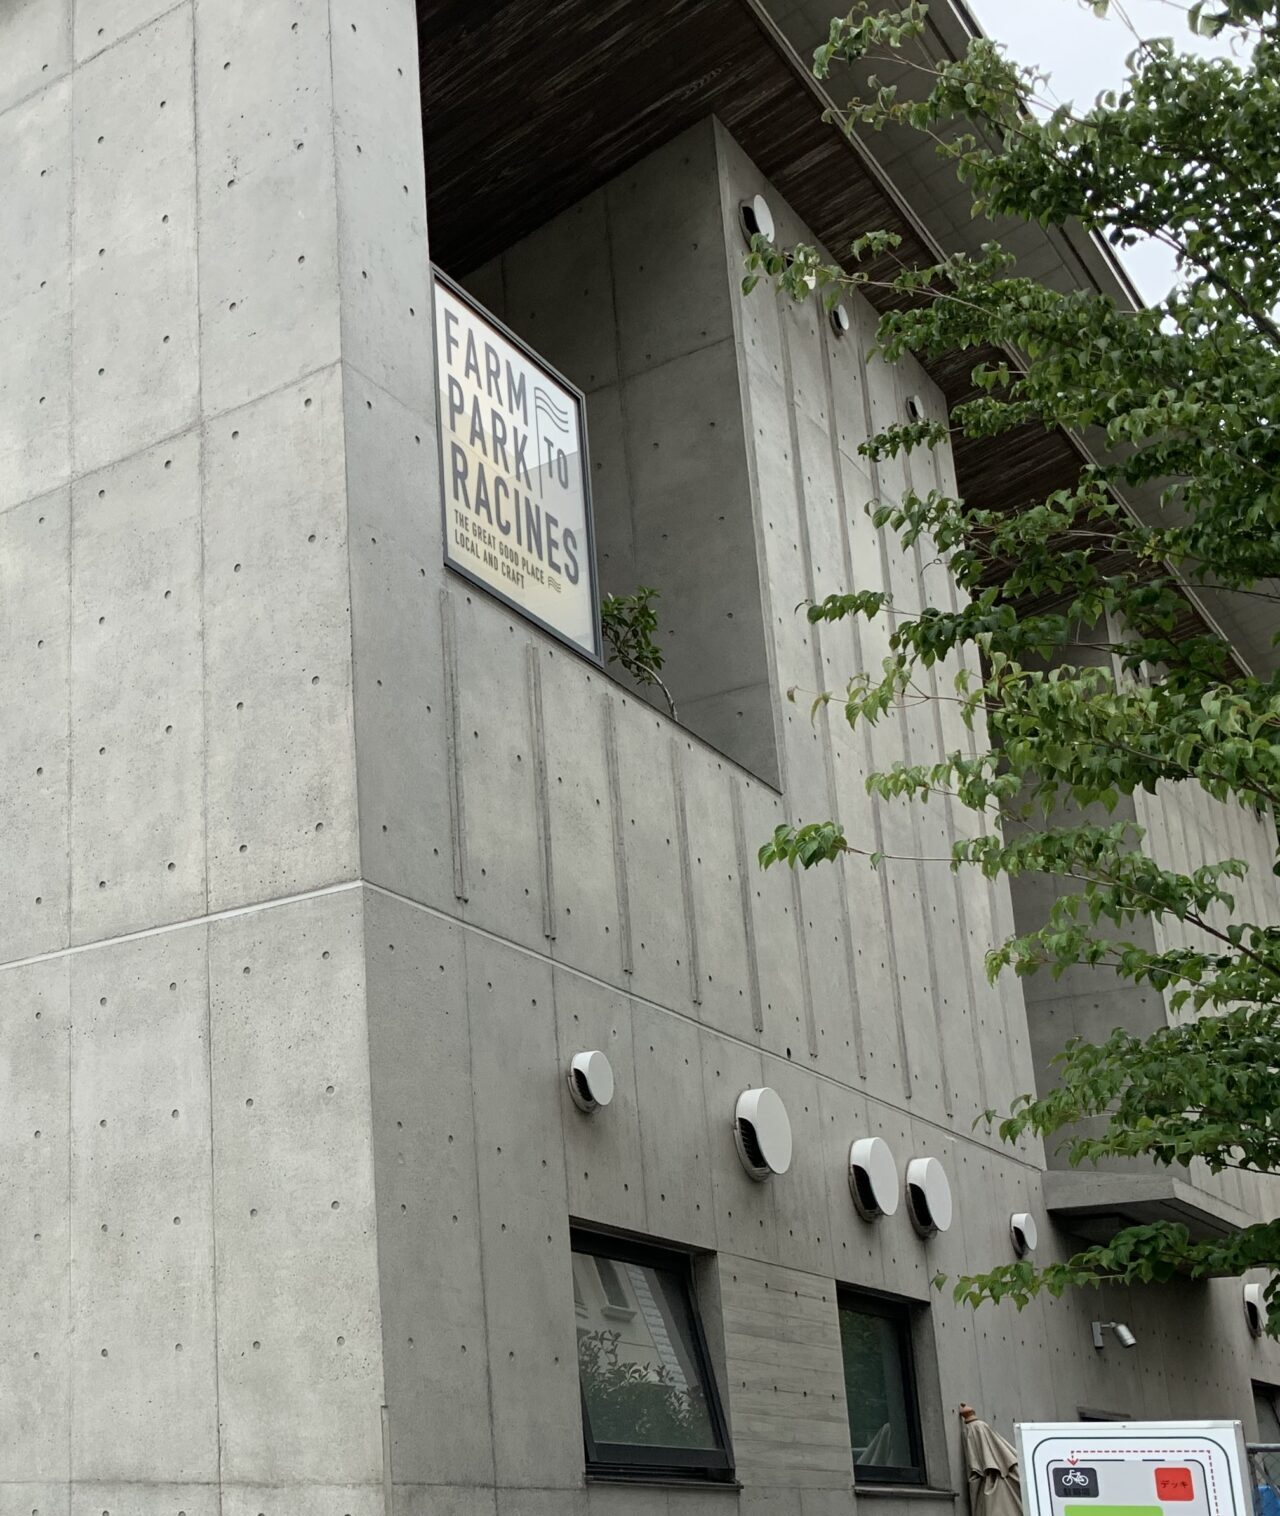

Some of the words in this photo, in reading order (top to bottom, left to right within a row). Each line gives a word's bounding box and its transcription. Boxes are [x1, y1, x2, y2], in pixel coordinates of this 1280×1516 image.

[444, 307, 528, 427] FARM
[448, 373, 532, 491] PARK
[544, 435, 569, 490] TO
[451, 441, 579, 585] RACINES
[454, 508, 469, 532] THE
[472, 521, 496, 549] GREAT
[499, 541, 519, 567] GOOD
[522, 556, 545, 585] PLACE
[454, 529, 480, 559] LOCAL
[483, 549, 498, 571] AND
[501, 562, 524, 589] CRAFT
